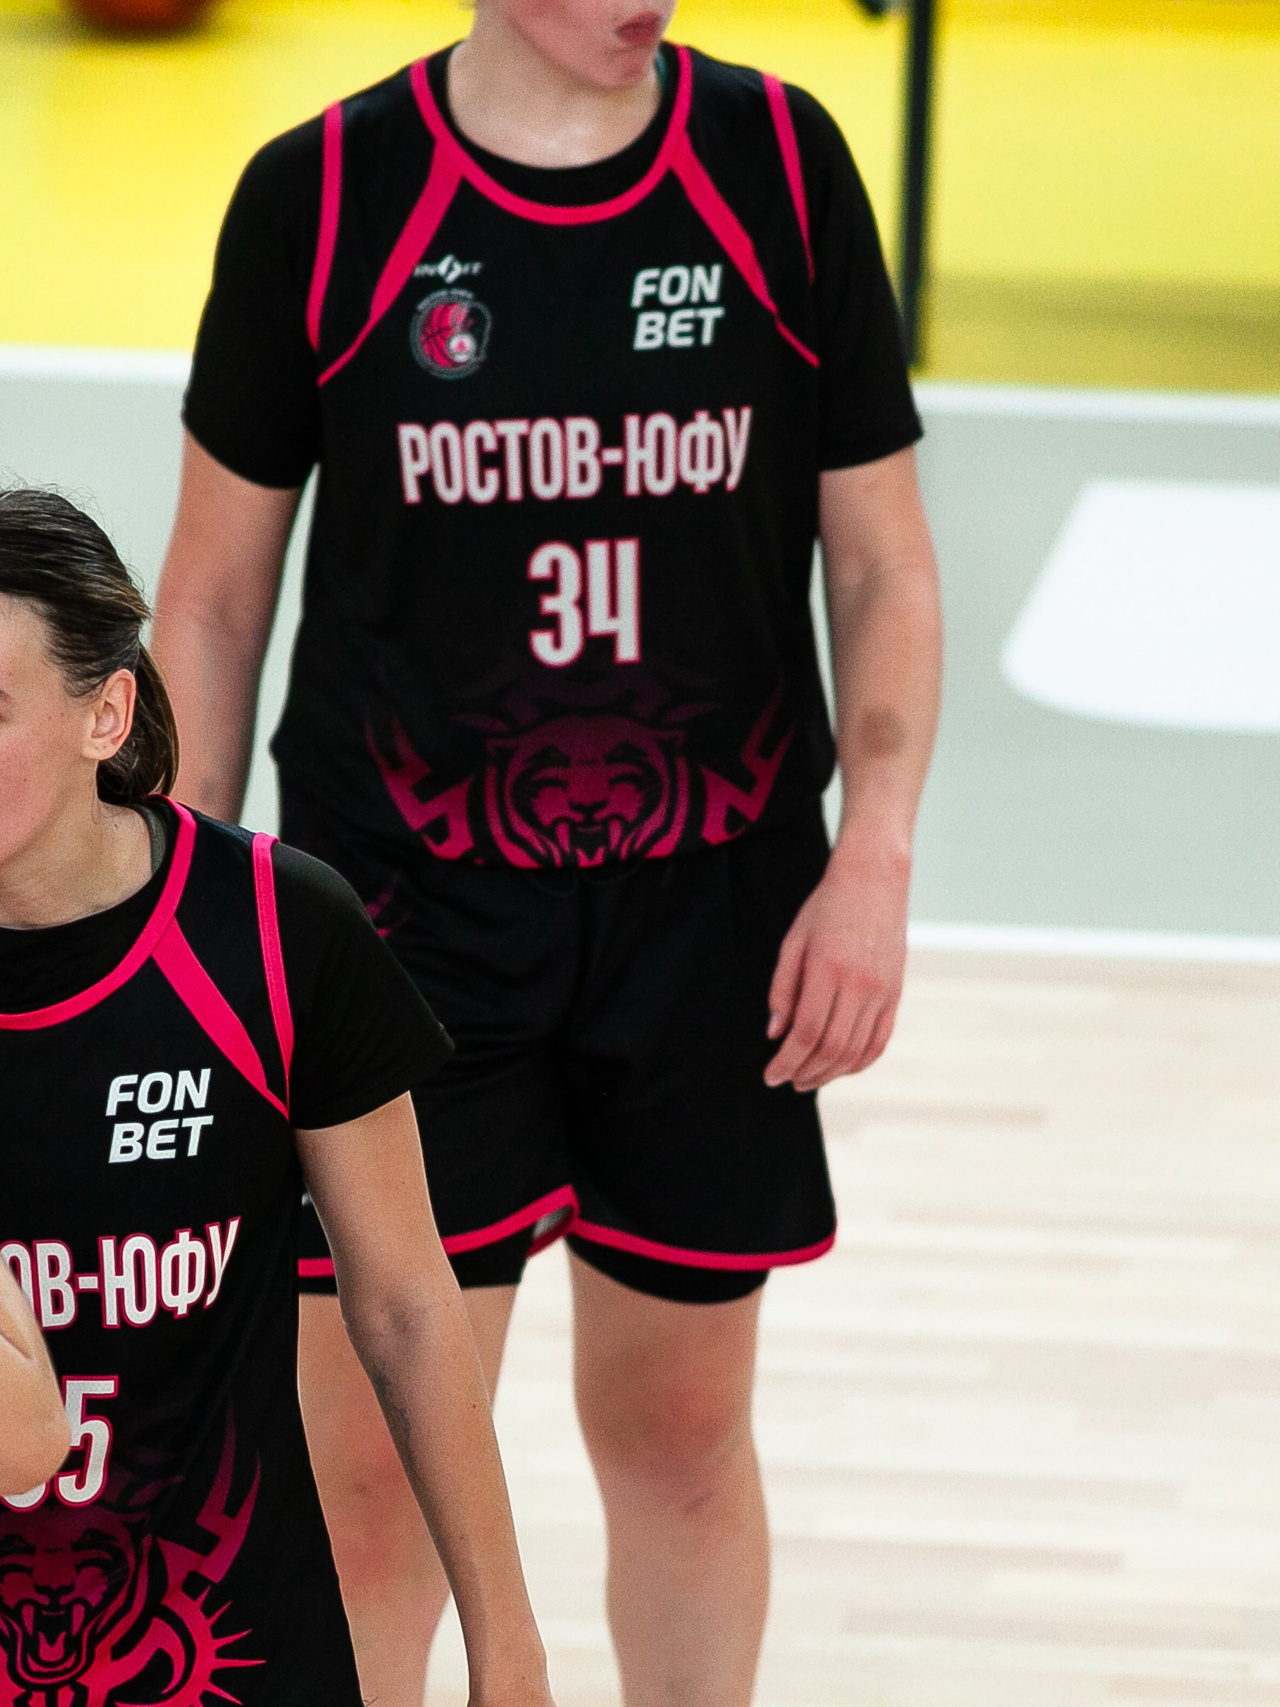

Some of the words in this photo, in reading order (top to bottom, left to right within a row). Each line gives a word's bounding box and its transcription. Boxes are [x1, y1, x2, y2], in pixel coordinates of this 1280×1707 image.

[631, 264, 723, 308] FON
[633, 307, 725, 351] BET
[397, 405, 752, 506] РОСТОВ-ЮФУ
[527, 536, 642, 667] 34
[105, 1067, 212, 1118] FON
[107, 1114, 214, 1165] BET
[0, 1375, 119, 1512] 5
